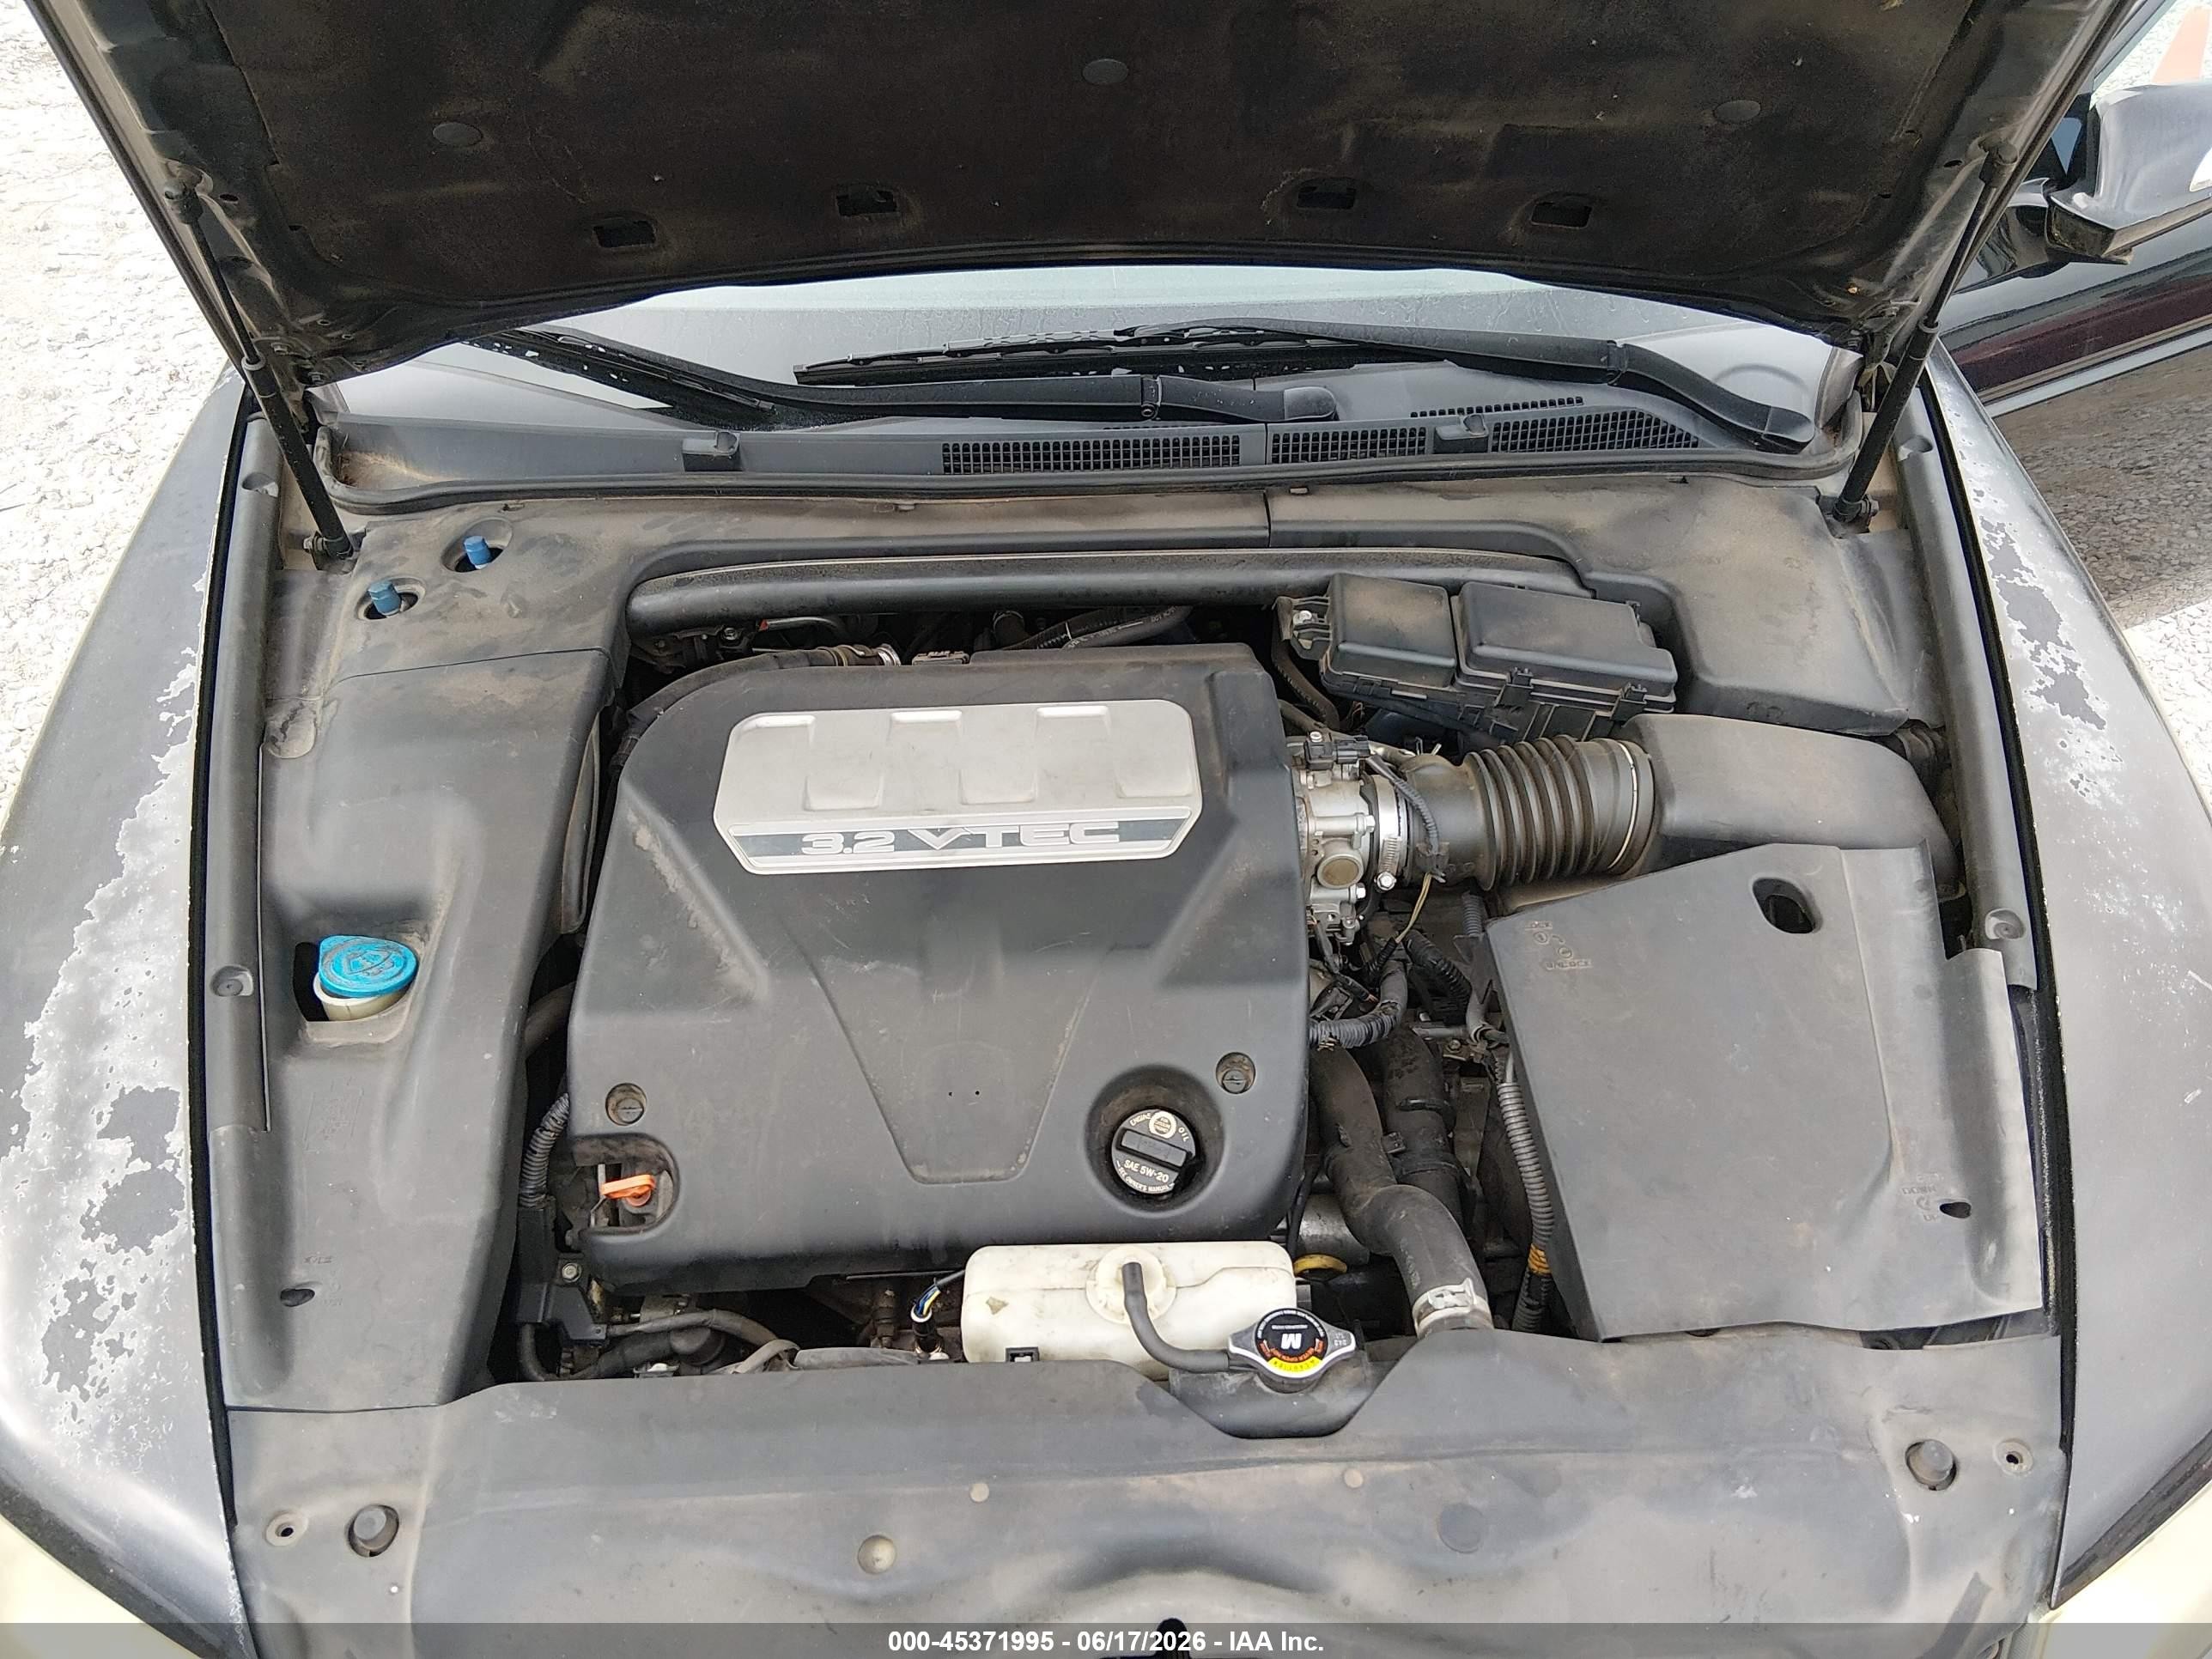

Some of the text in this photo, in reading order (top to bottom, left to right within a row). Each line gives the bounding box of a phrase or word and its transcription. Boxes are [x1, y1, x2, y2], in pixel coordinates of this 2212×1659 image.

[801, 821, 1120, 855] 3.2 VTEC
[1545, 959, 1591, 970] UNLOCK
[1130, 1113, 1189, 1142] ENGINE OIL
[1123, 1159, 1169, 1182] SAE 5W-20
[1126, 1176, 1147, 1192] OWNER'S
